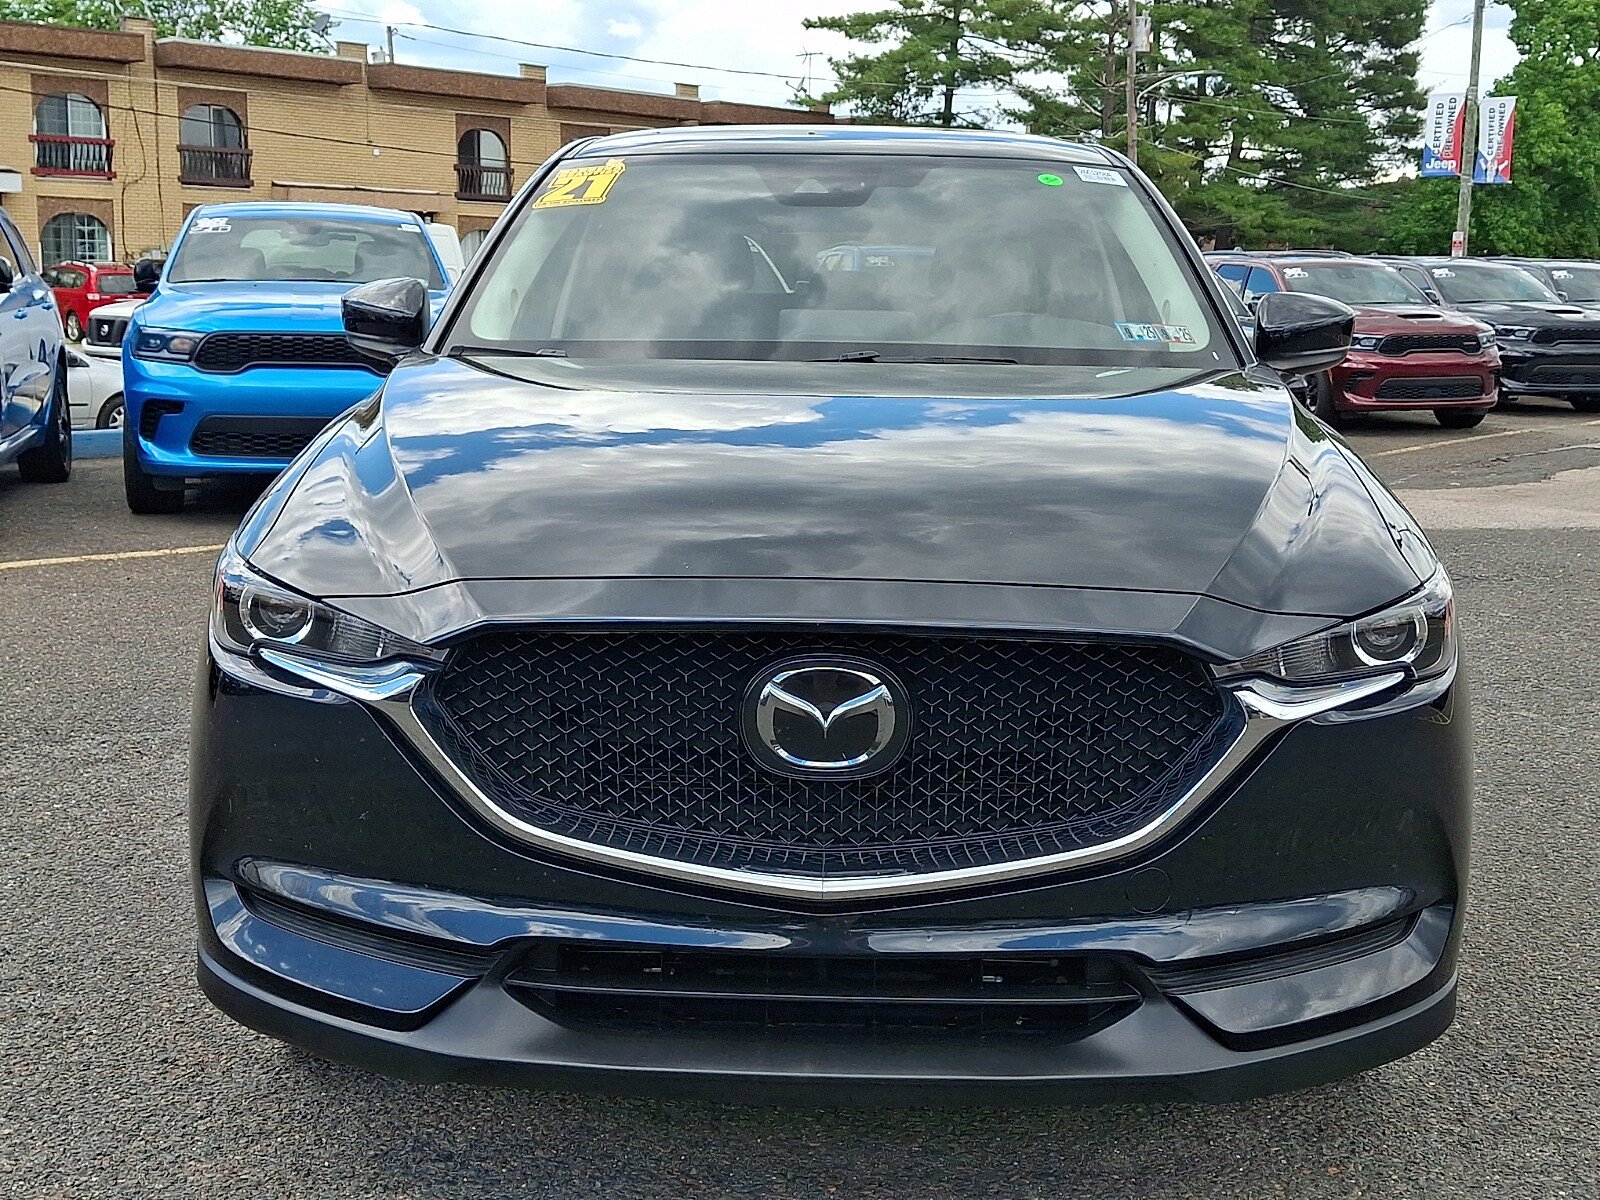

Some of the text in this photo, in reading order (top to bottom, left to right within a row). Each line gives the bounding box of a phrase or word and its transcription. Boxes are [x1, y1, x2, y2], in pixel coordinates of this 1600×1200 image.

[1433, 102, 1444, 155] CERTIFIED
[1487, 107, 1496, 156] CERTIFIED
[1425, 158, 1457, 171] Jeep
[540, 173, 617, 202] 21
[1142, 325, 1157, 339] 25
